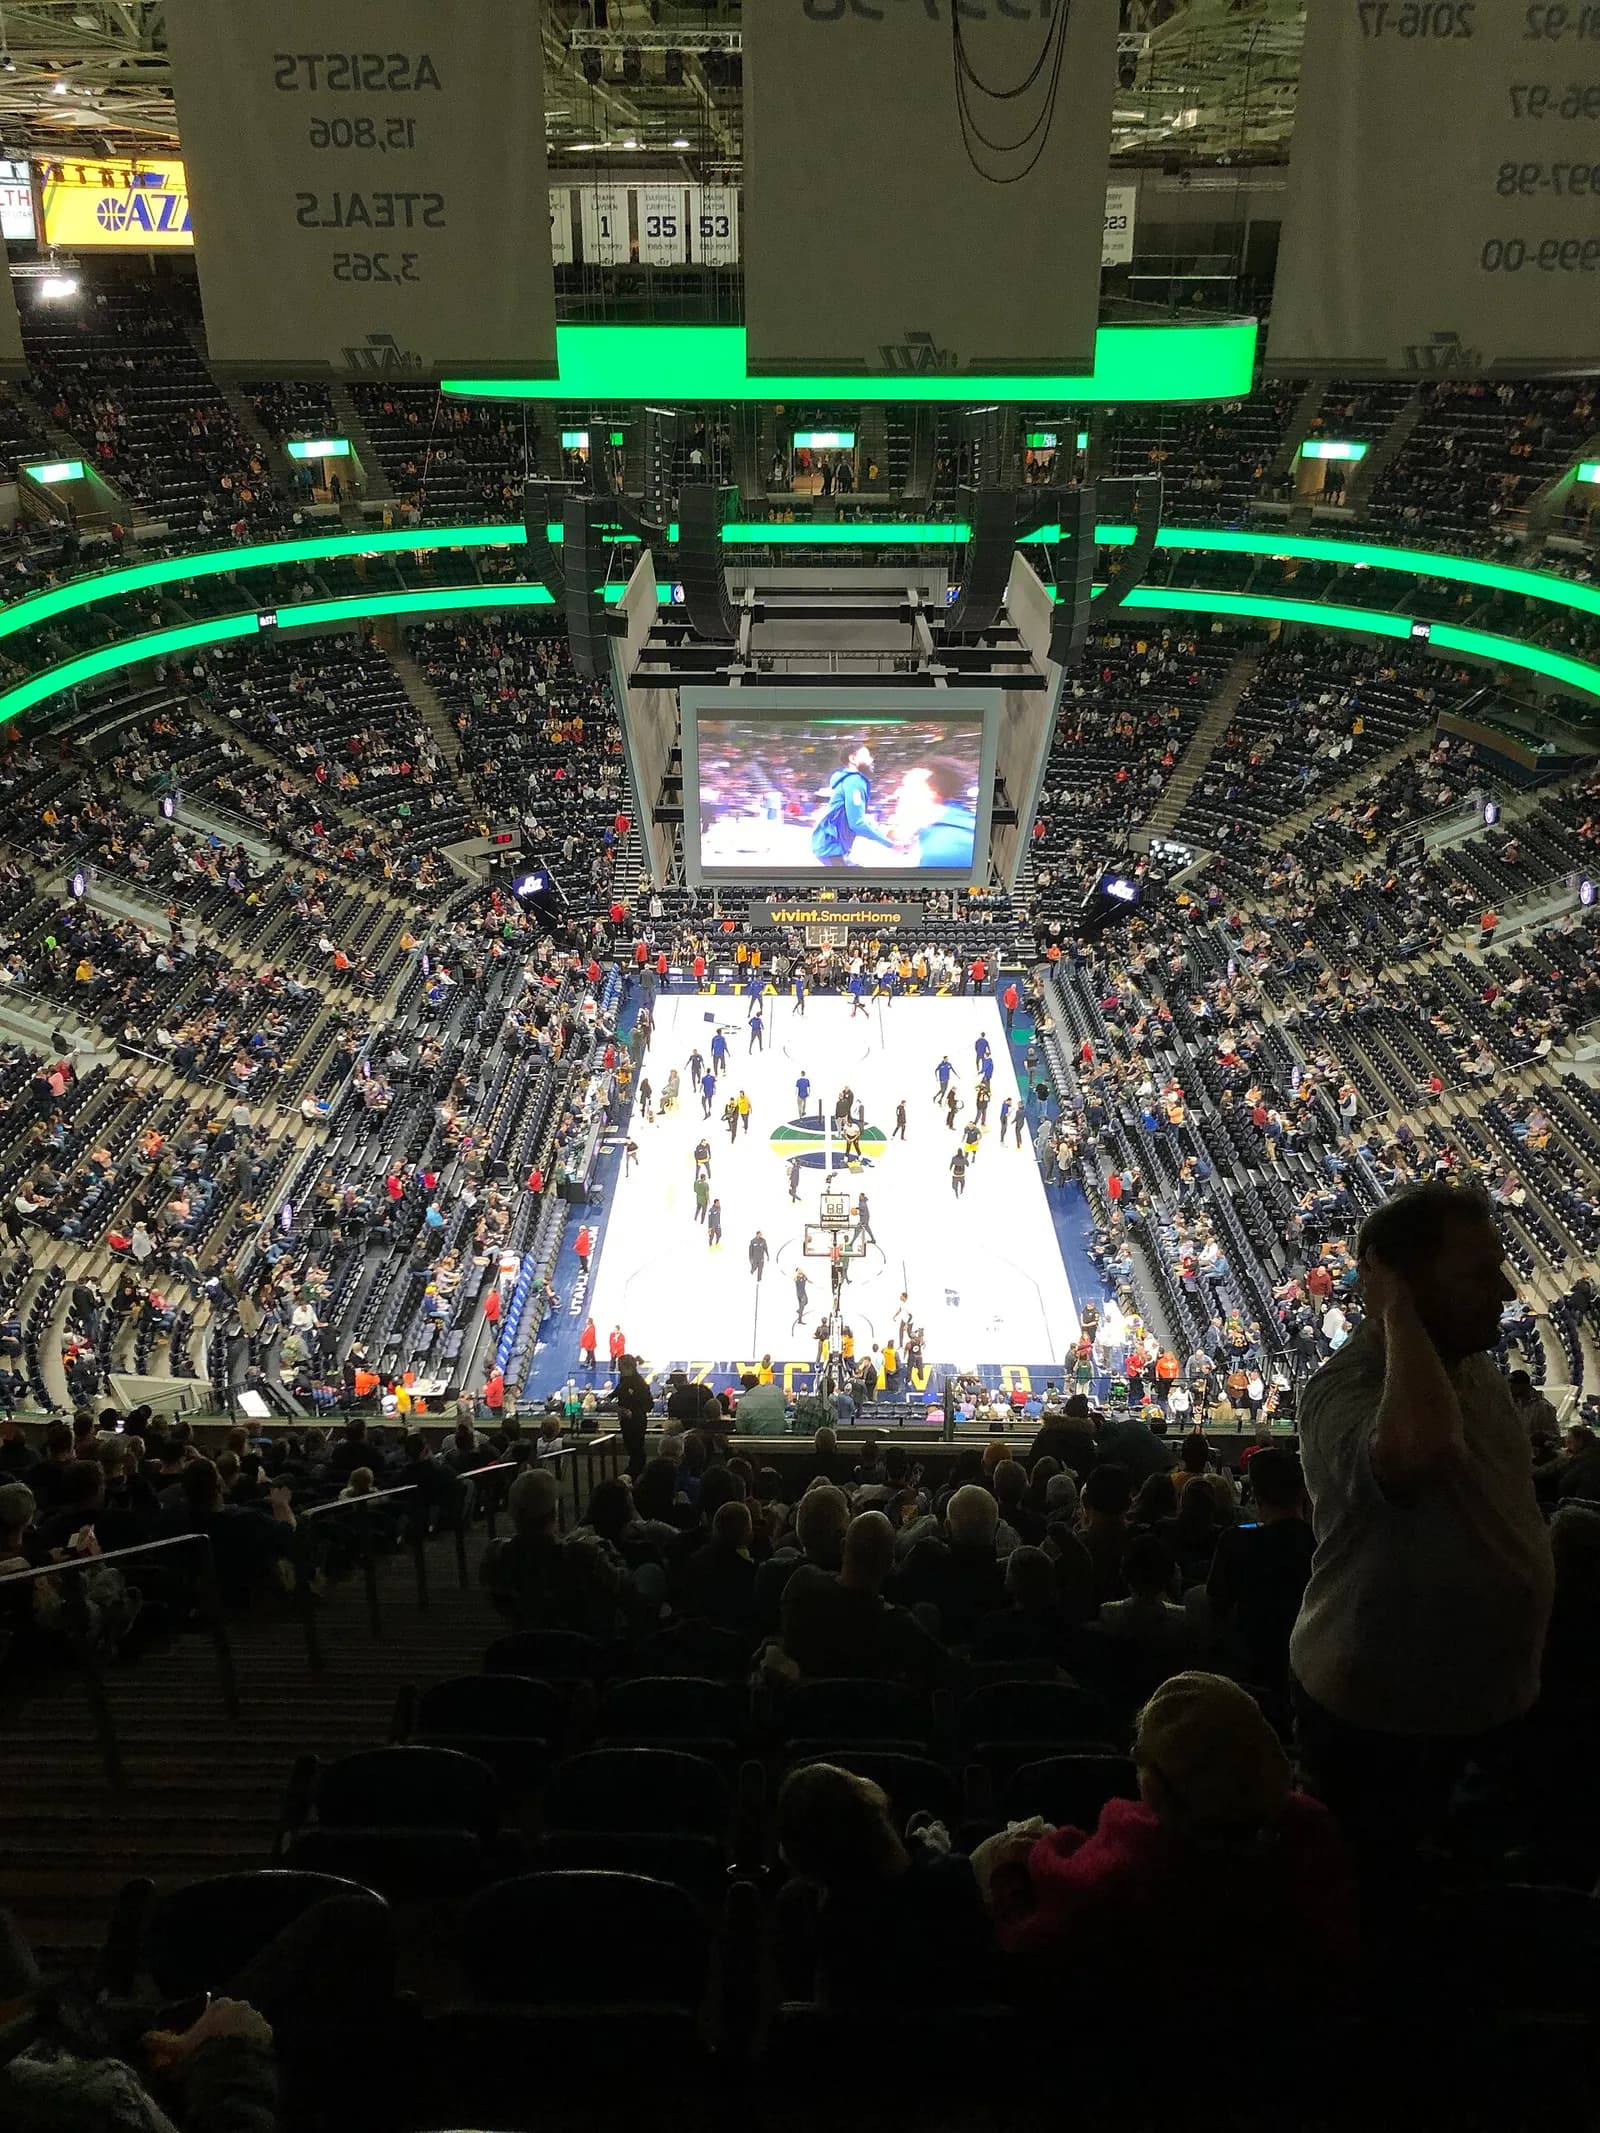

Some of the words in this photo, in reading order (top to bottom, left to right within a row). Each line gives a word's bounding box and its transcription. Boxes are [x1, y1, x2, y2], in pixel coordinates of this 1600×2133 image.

[601, 216, 610, 238] 1
[647, 216, 677, 238] 35
[700, 216, 730, 238] 53
